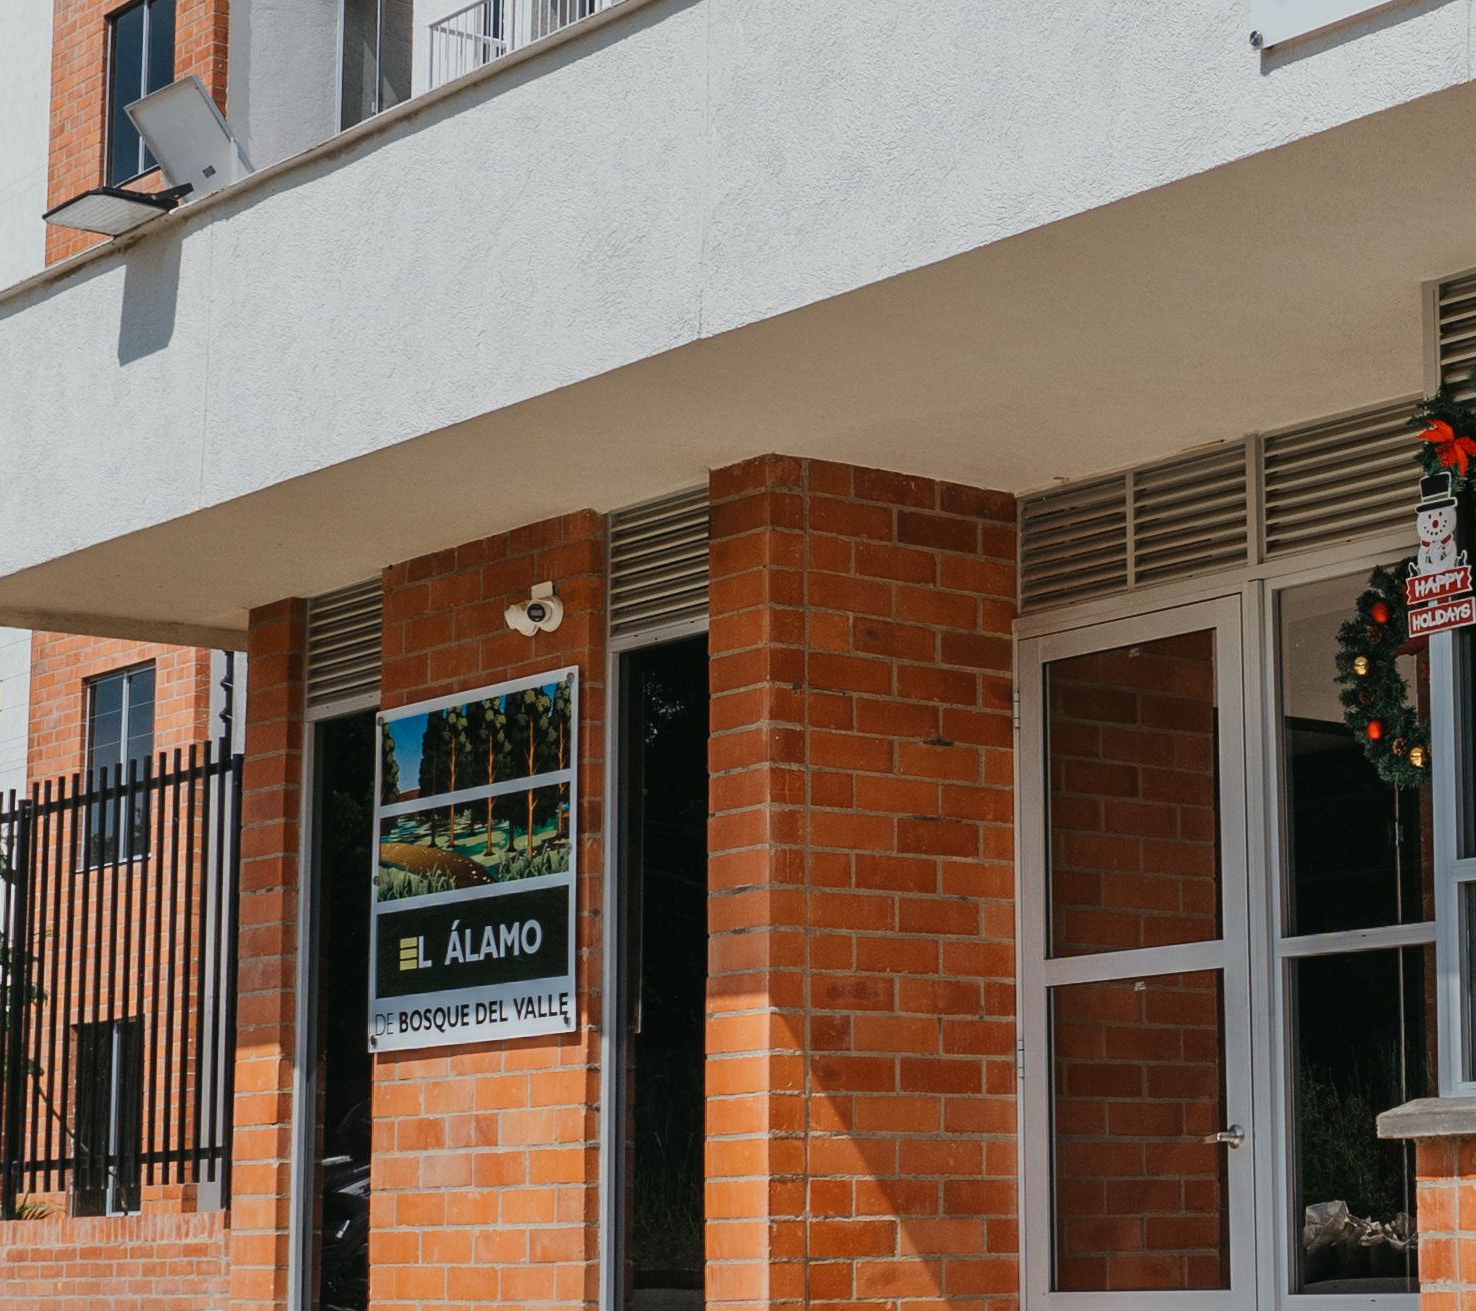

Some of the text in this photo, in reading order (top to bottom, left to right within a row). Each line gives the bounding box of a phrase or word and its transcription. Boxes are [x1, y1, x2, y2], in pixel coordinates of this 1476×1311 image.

[1414, 571, 1465, 598] HAPPY
[1412, 603, 1471, 631] HOLIDAYS
[399, 919, 543, 971] EL ÁLAMO
[375, 992, 569, 1036] DE BOSQUE DEL VALLE
